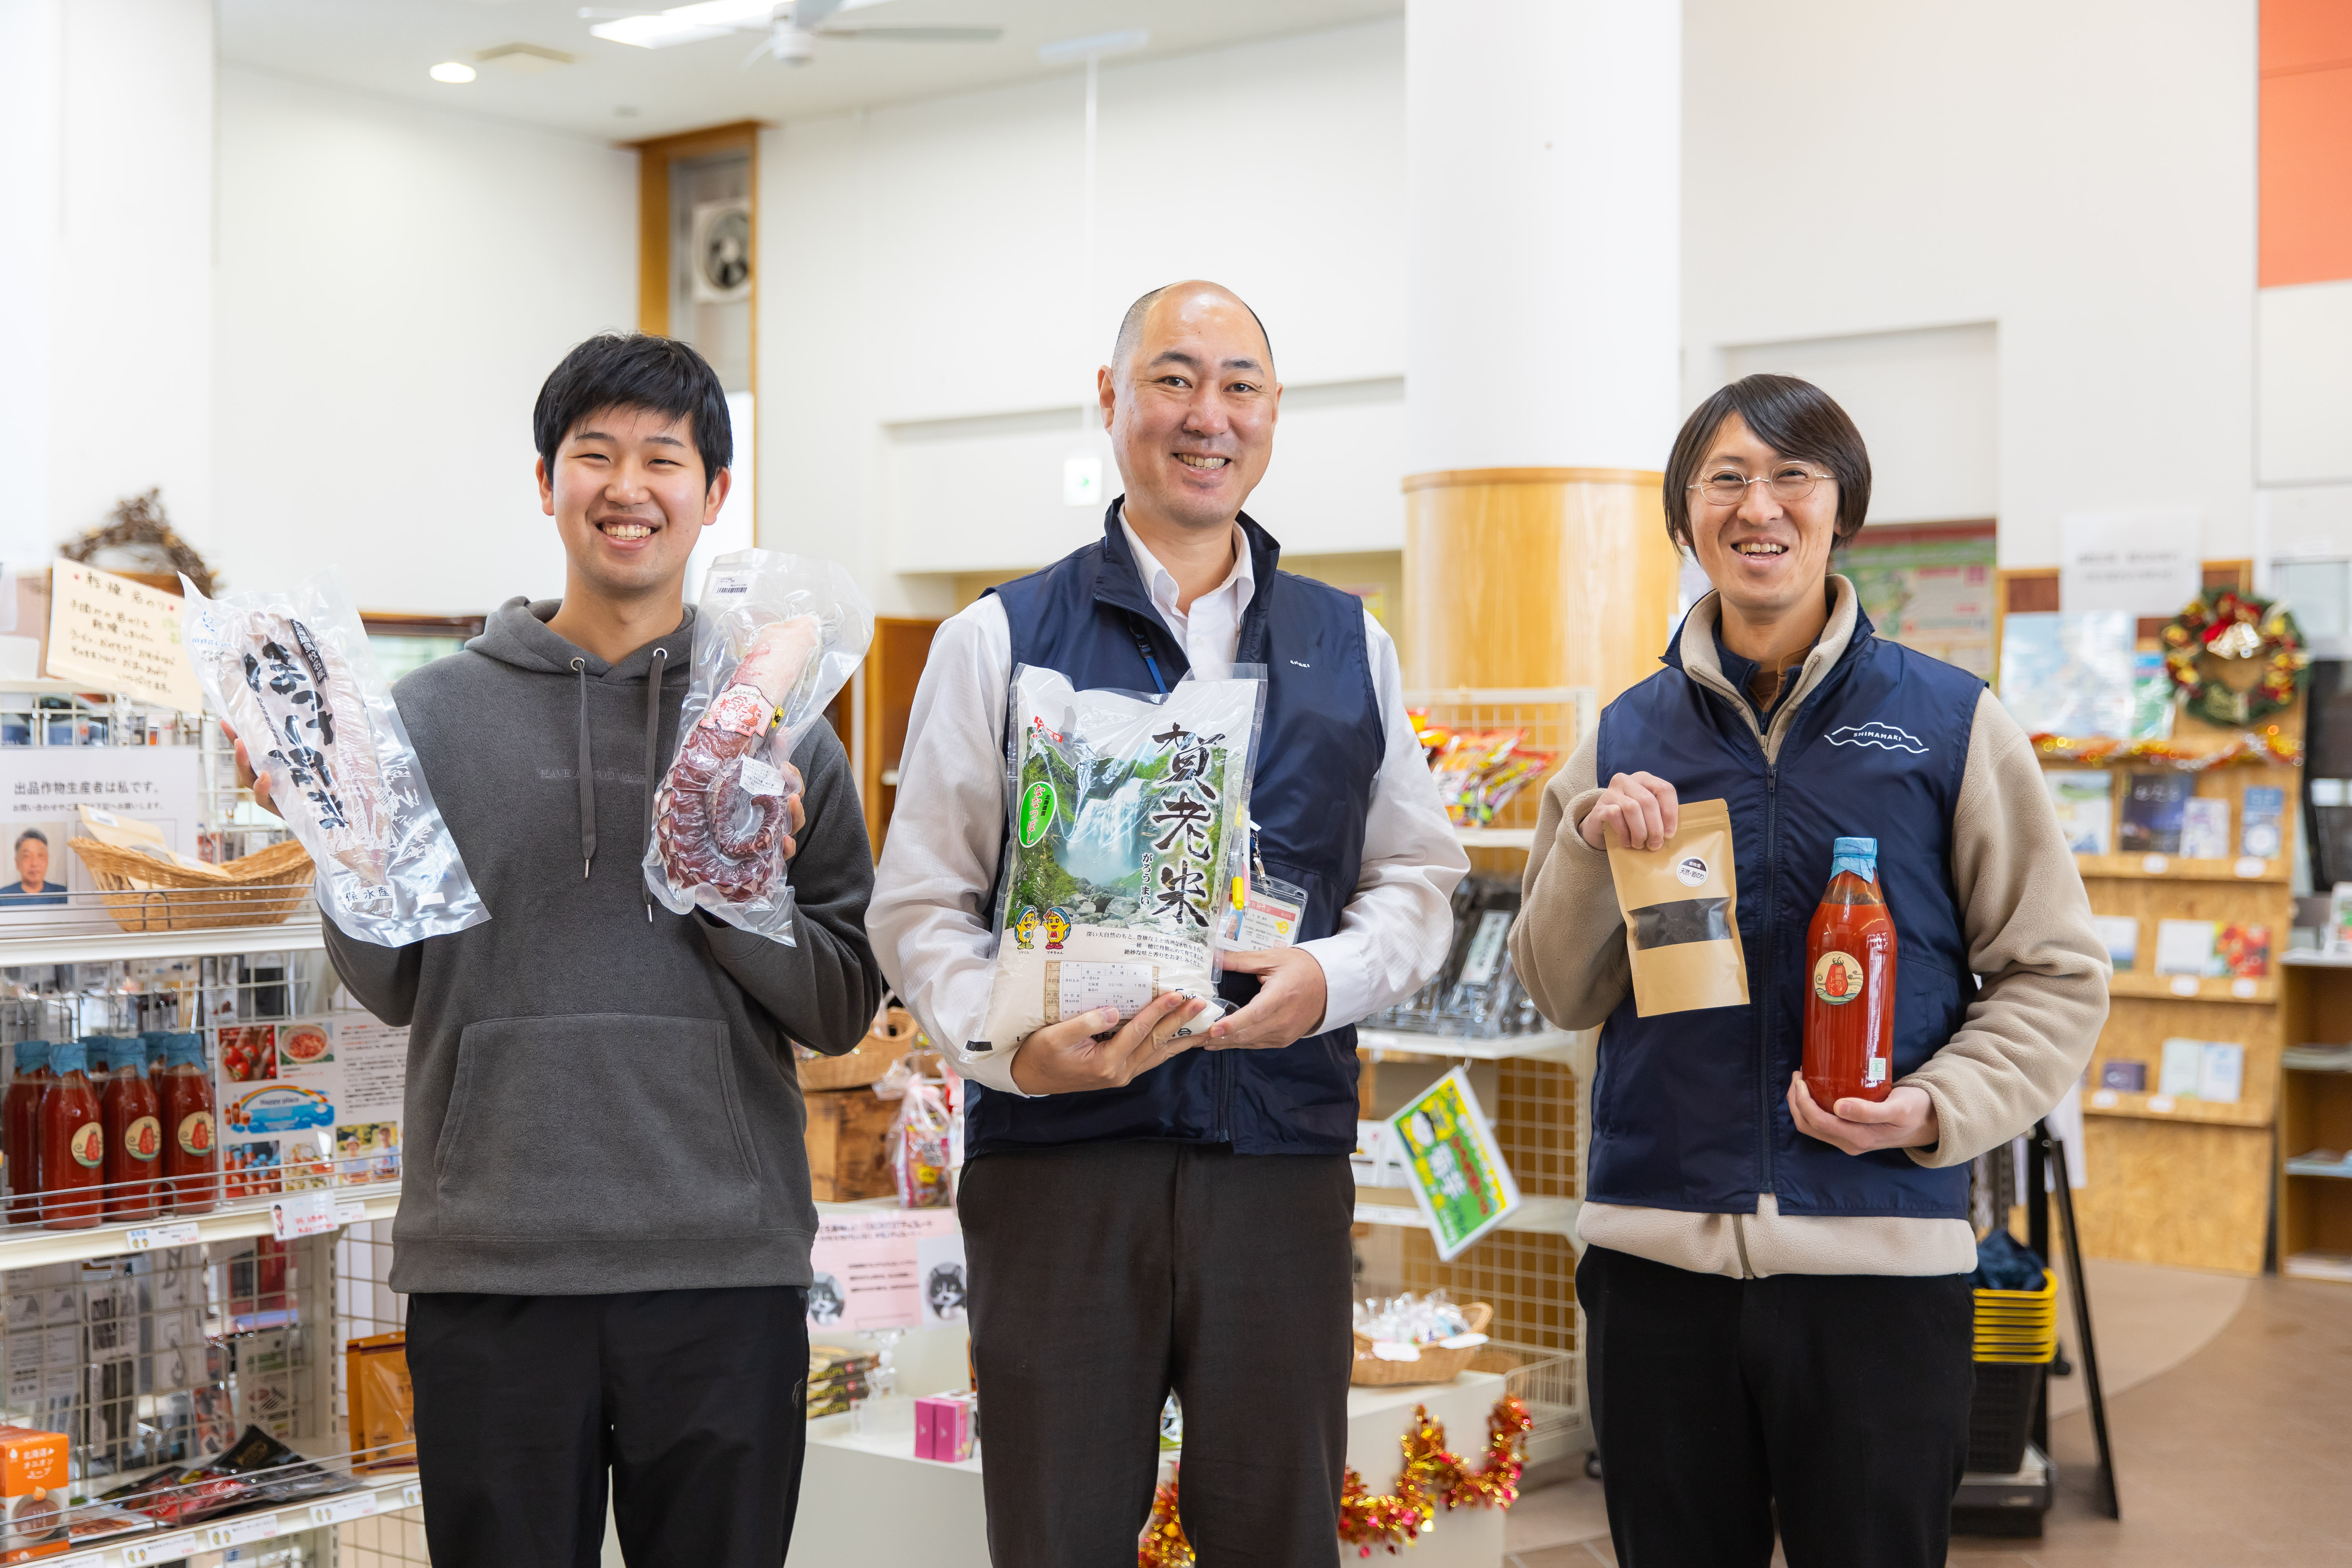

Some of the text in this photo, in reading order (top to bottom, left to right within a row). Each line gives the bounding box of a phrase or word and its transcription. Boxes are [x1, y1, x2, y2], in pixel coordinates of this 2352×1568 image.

[1853, 731, 1901, 741] SHIMAMAKI
[541, 768, 571, 778] HAVE
[592, 770, 615, 780] OOD
[14, 781, 159, 795] 出品作物生産者は私です。
[1041, 795, 1051, 816] 北海道産
[1026, 784, 1046, 844] ななつぼし
[1151, 722, 1225, 928] 賀老米
[1140, 852, 1154, 906] がろうまい
[1680, 868, 1704, 880] 天然・岩のり
[260, 1096, 300, 1106] Happy place
[23, 1447, 47, 1460] 北海道
[24, 1458, 54, 1470] オニオン
[27, 1466, 52, 1479] スープ
